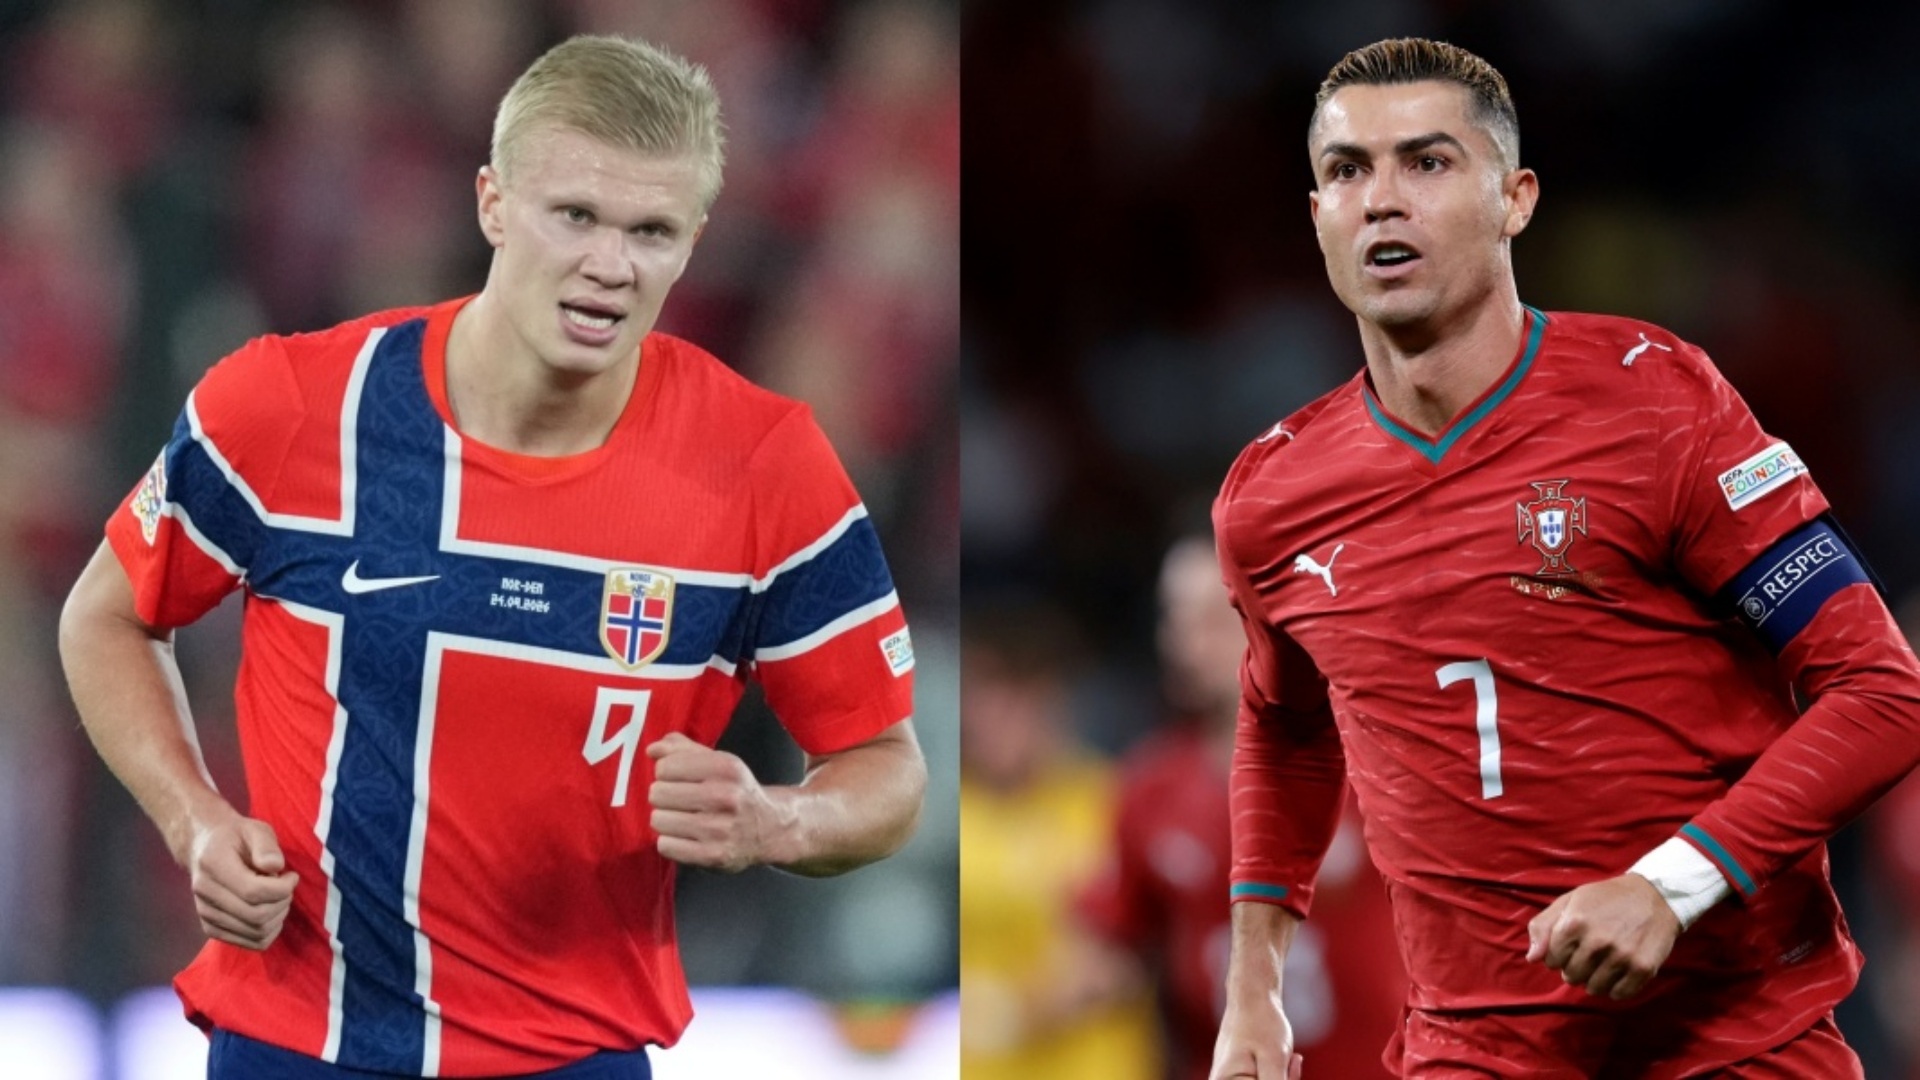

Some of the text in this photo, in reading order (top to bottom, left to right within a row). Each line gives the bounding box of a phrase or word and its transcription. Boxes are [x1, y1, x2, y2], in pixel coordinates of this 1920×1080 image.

[1721, 468, 1744, 486] UEFA
[501, 577, 544, 595] NOR-DEN
[1762, 537, 1839, 601] RESPECT
[581, 685, 653, 808] 9
[1434, 656, 1504, 801] 7
